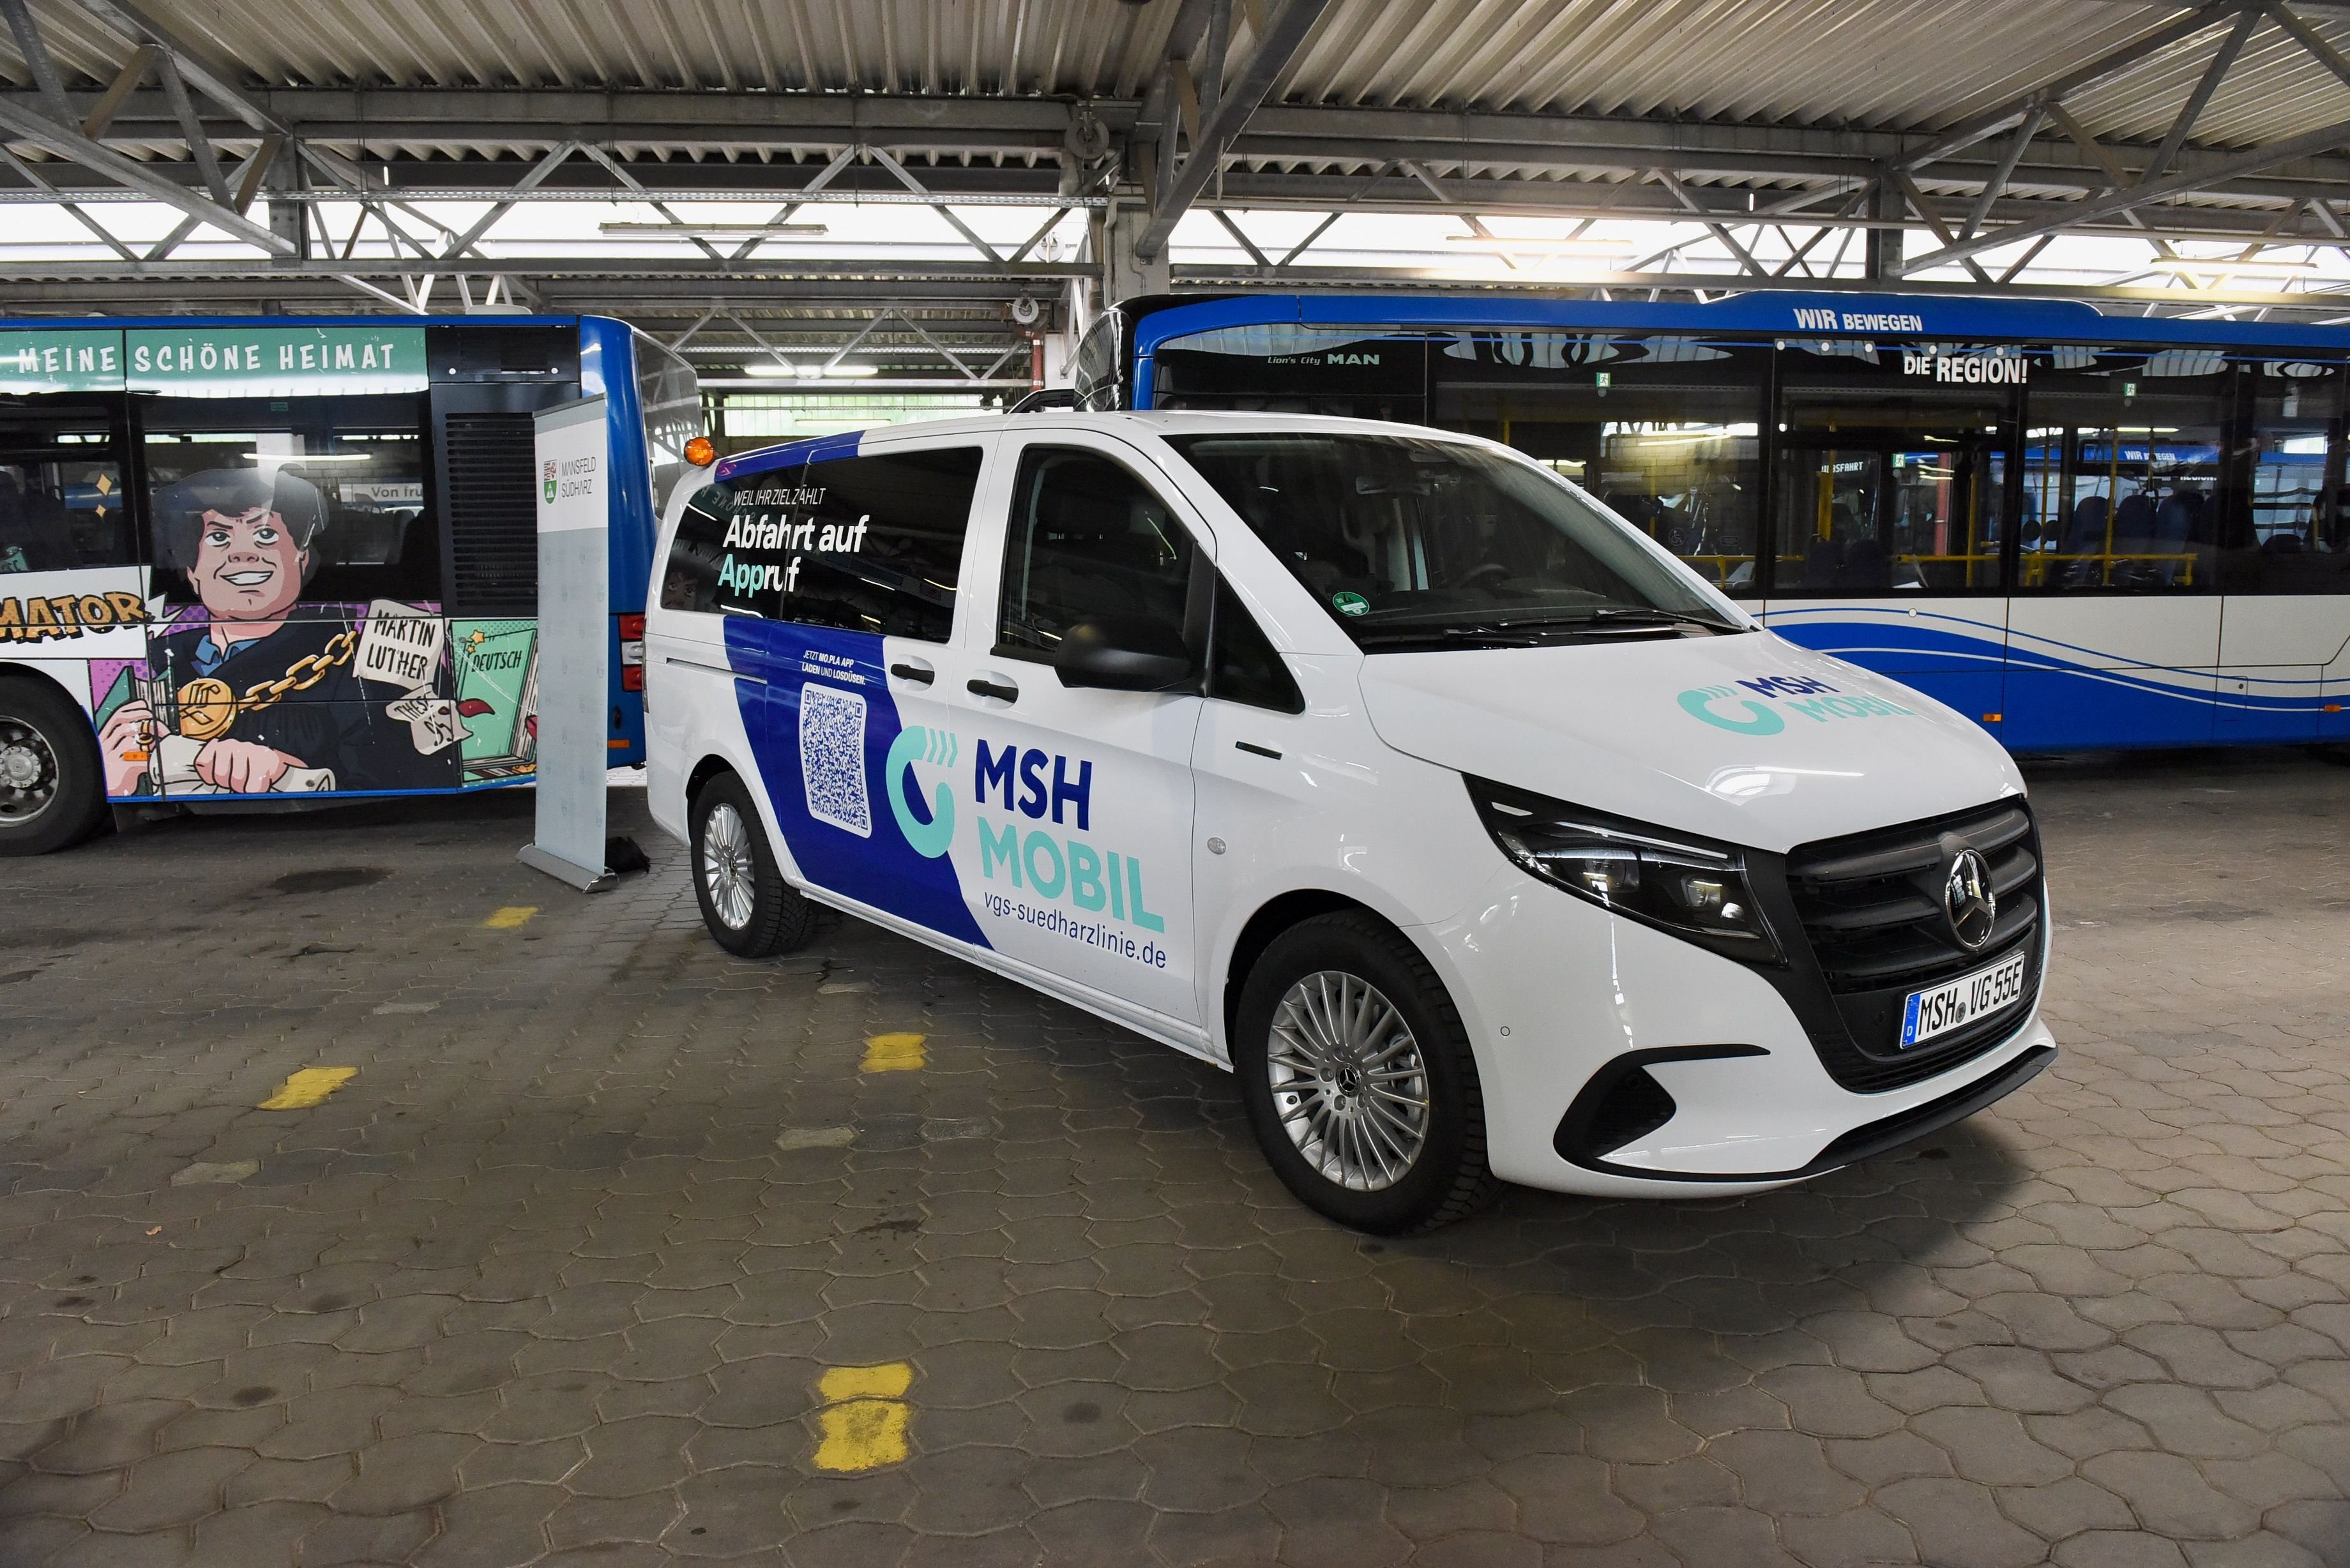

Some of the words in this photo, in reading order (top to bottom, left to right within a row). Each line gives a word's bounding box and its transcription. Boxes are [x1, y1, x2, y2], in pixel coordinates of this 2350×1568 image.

[1793, 308, 1838, 329] WIR
[1842, 313, 1923, 331] BEWEGEN
[19, 346, 116, 373] MEINE
[135, 343, 262, 372] SCHÖNE
[279, 343, 394, 370] HEIMAT
[1300, 356, 1321, 366] City
[1327, 354, 1380, 365] MAN
[1904, 356, 1930, 375] DIE
[1936, 356, 2028, 384] REGION!
[561, 456, 596, 477] MANSFELD
[2125, 450, 2142, 460] WIR
[372, 486, 398, 497] Von
[561, 479, 592, 498] SÜDHARZ
[734, 490, 754, 506] WEIL
[754, 488, 771, 506] IHR
[770, 488, 791, 506] ZIEL
[791, 484, 826, 505] ZÄHLT
[722, 515, 815, 550] Abfahrt
[819, 515, 870, 552] auf
[717, 554, 801, 598] Appruf
[374, 609, 436, 647] MARTIN
[367, 643, 428, 680] LUTHER
[471, 650, 522, 672] DEUTSCH
[803, 650, 819, 660] JETZT
[819, 652, 840, 665] MO.PLA
[841, 658, 854, 668] APP
[802, 662, 820, 675] LADEN
[821, 667, 832, 677] UND
[833, 669, 865, 685] LOSDÜSEN.
[1735, 676, 1841, 698] MSH
[1783, 695, 1917, 723] MOBIL
[976, 739, 1092, 831] MSH
[977, 815, 1165, 933] MOBIL
[985, 891, 1166, 969] vgs-suedharzlinie.de
[1918, 987, 1958, 1036] MSH
[1971, 974, 1992, 1015] VG
[1993, 960, 2023, 1005] 55E
[1906, 1025, 1913, 1036] D
